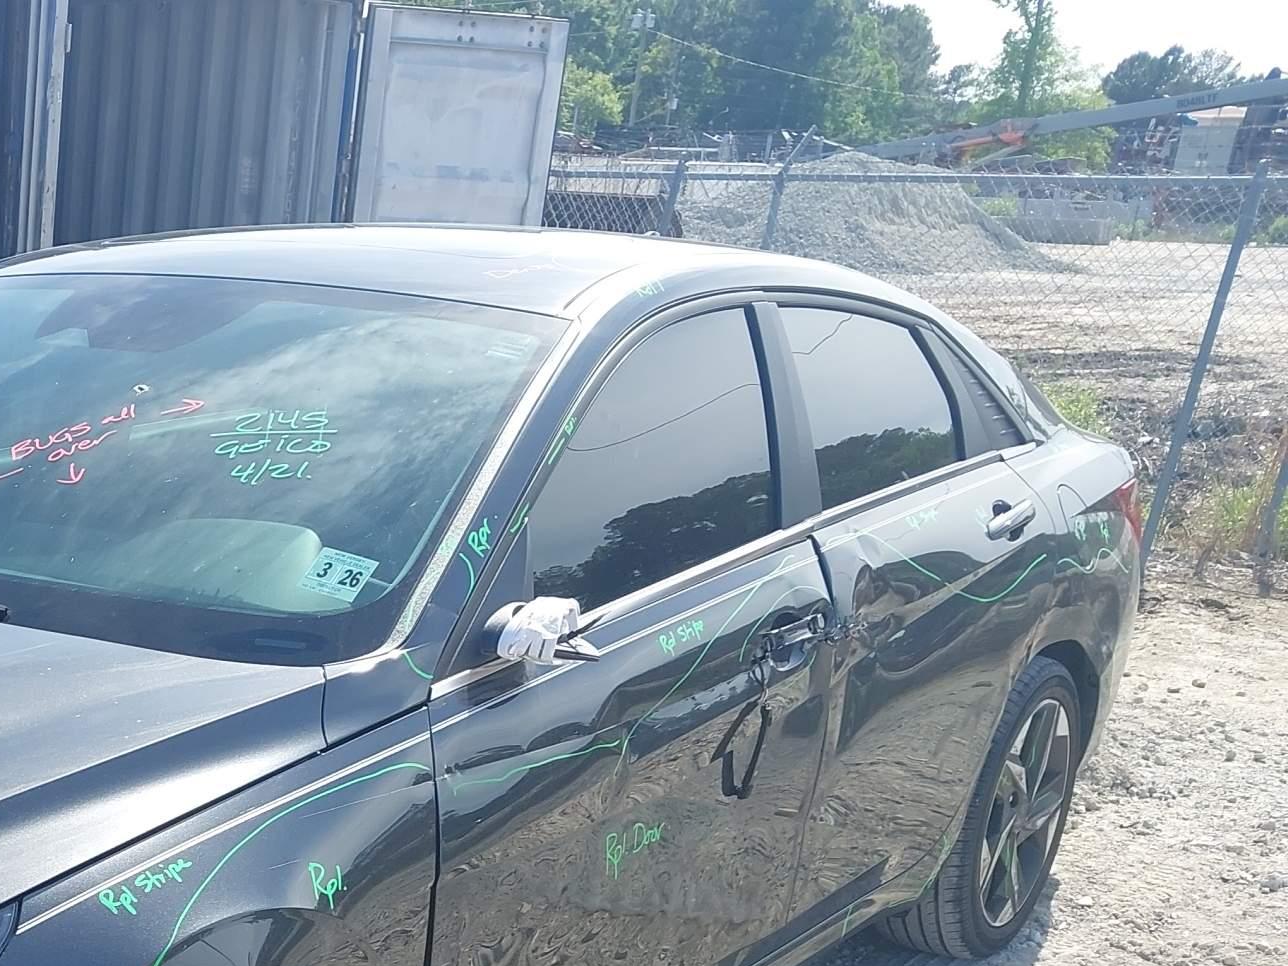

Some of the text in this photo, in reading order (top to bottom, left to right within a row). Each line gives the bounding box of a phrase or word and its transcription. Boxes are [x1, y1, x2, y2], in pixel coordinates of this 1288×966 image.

[316, 561, 333, 578] 3
[337, 569, 363, 588] 26
[632, 822, 665, 854] Door
